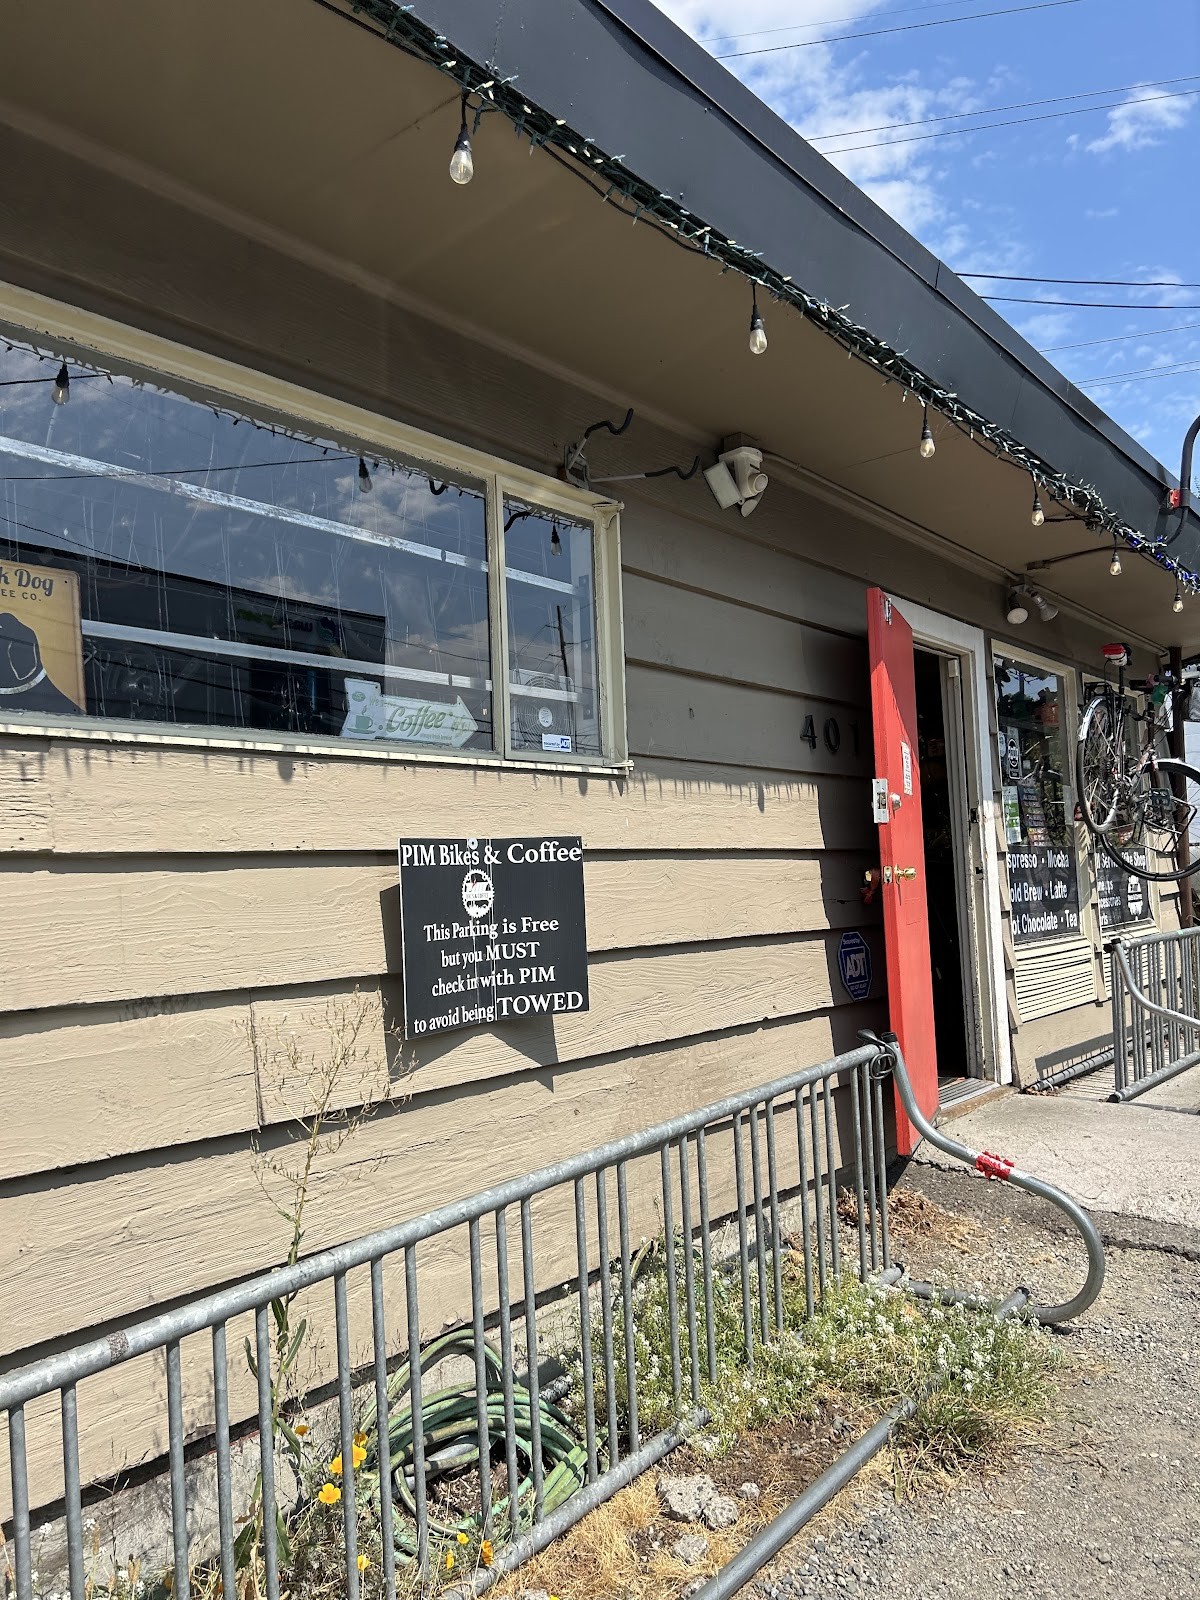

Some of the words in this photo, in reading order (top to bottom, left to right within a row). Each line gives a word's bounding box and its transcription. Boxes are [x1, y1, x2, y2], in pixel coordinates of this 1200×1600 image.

[14, 568, 54, 597] Dog
[22, 591, 42, 602] CO.
[386, 705, 447, 738] Coffee
[800, 714, 859, 755] 401
[402, 844, 436, 867] PIM
[440, 843, 480, 866] Bikes
[484, 845, 502, 865] &
[507, 840, 582, 864] Coffee
[1047, 849, 1070, 868] Mocha
[1133, 851, 1146, 870] Shop
[1023, 881, 1044, 902] Brew
[1049, 880, 1068, 900] Latte
[423, 923, 450, 942] This
[452, 920, 499, 940] Parking
[502, 918, 517, 934] is
[520, 916, 560, 933] Free
[1021, 911, 1058, 934] Chocolate
[1064, 909, 1078, 928] Tea
[441, 949, 461, 968] but
[462, 951, 483, 970] you
[486, 941, 540, 962] MUST
[846, 952, 866, 980] ADT
[432, 975, 465, 998] check
[466, 976, 479, 991] in
[479, 969, 515, 988] with
[519, 966, 556, 985] PIM
[413, 1018, 427, 1034] to
[429, 1009, 460, 1031] avoid
[462, 1003, 494, 1023] being
[496, 990, 583, 1016] TOWED
